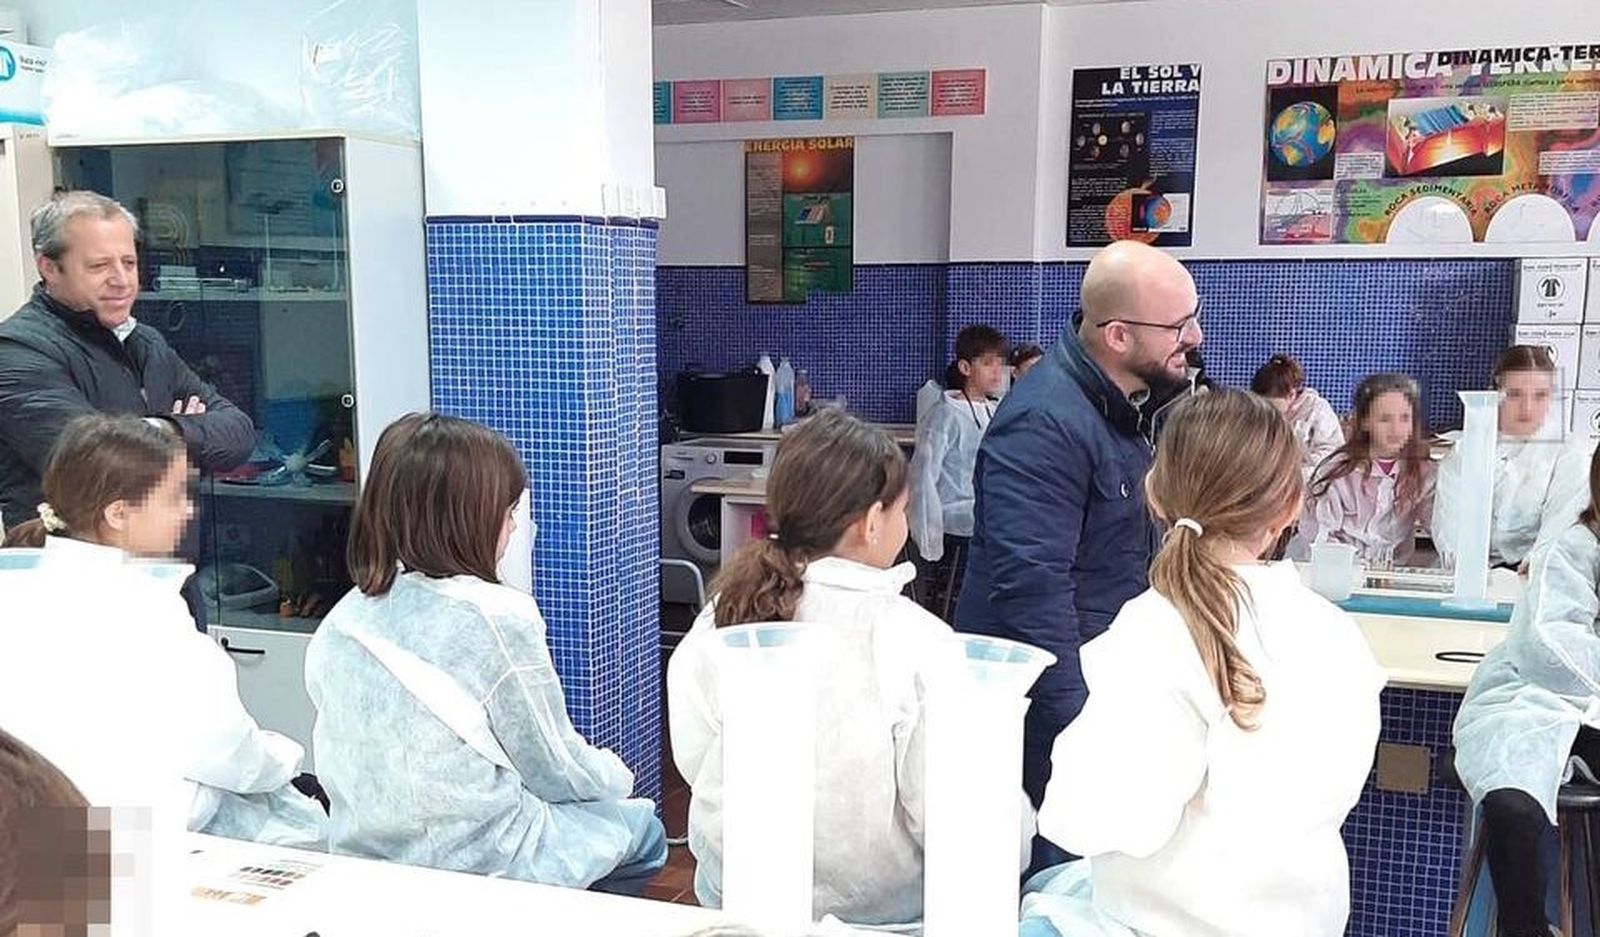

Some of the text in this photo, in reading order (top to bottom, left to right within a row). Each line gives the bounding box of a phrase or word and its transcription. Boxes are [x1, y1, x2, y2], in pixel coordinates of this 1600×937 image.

[1120, 66, 1141, 80] EL
[1148, 65, 1182, 79] SOL
[1267, 52, 1452, 85] DINAMICA
[1101, 79, 1200, 95] LA TIERRA
[808, 137, 853, 150] SOLAR
[1384, 193, 1408, 216] ROCA
